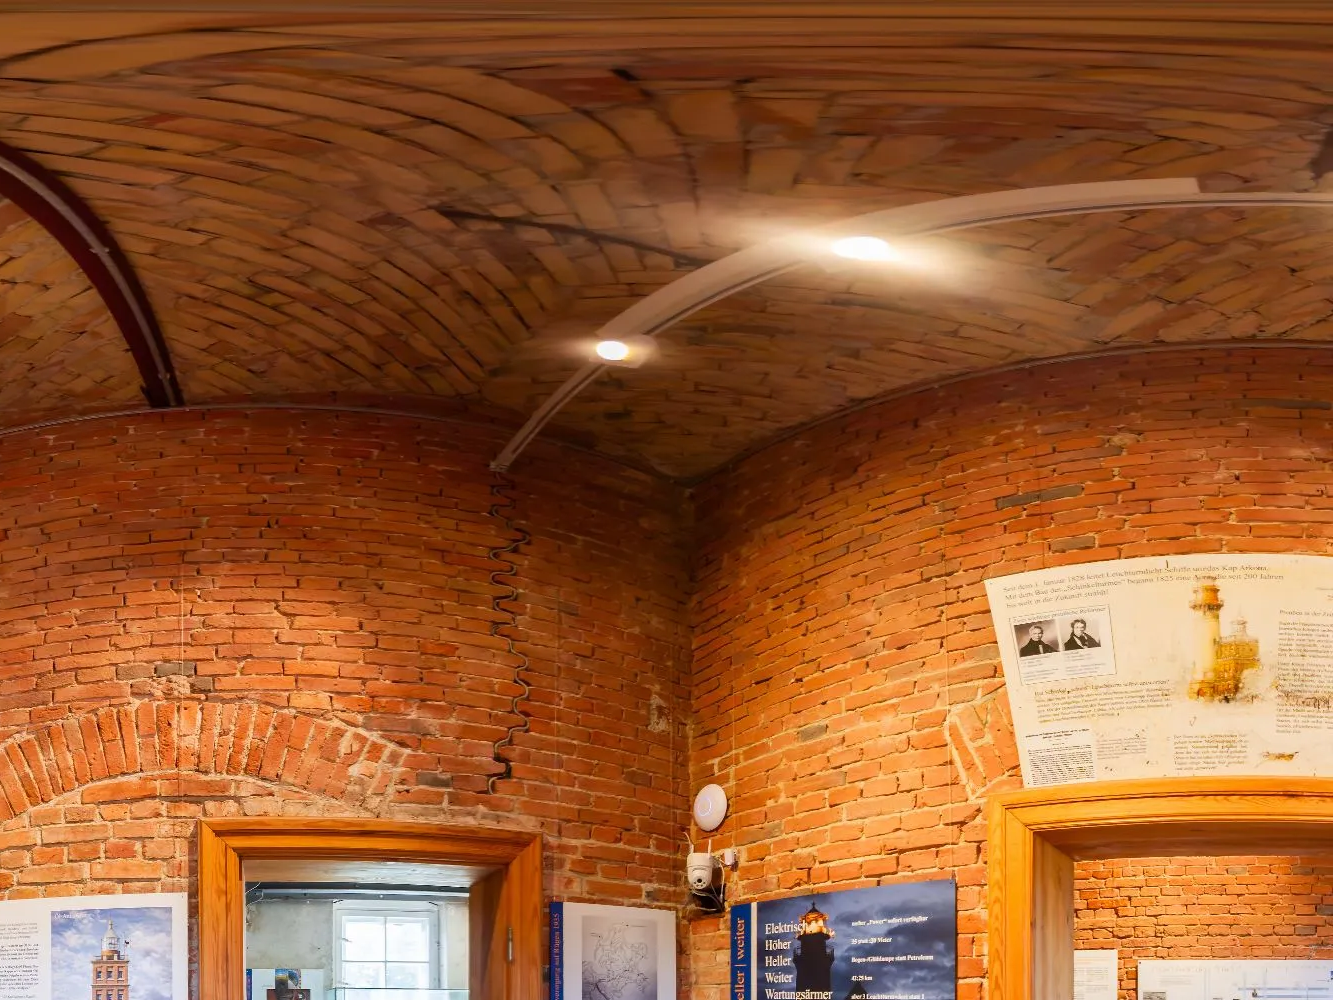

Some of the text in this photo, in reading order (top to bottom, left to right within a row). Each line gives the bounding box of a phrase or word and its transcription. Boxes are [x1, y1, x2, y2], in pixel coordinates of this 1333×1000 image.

[1222, 565, 1238, 573] Kap
[1019, 591, 1033, 599] dem
[765, 920, 807, 935] Elektrisch
[734, 917, 744, 959] weiter
[765, 939, 792, 951] Höher
[765, 955, 792, 967] Heller
[765, 972, 793, 983] Weiter
